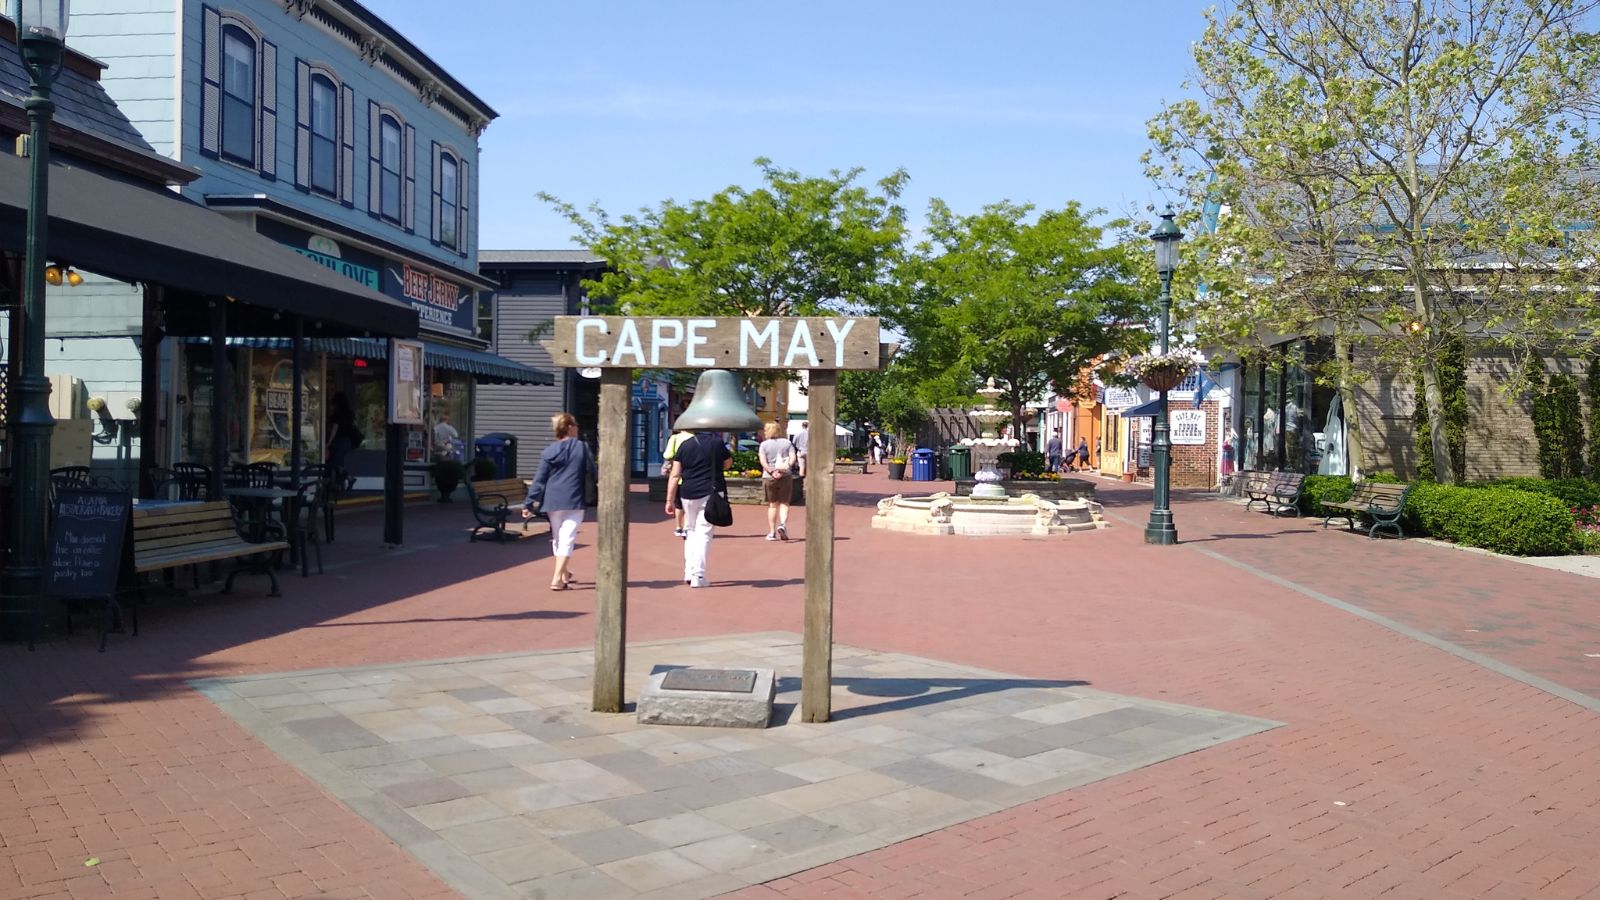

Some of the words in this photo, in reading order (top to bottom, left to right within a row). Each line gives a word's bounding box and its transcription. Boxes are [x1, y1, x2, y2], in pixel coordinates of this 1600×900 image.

[403, 262, 428, 302] BEEF
[428, 273, 460, 312] JERKY
[575, 318, 717, 367] CAPE
[739, 319, 856, 367] MAY
